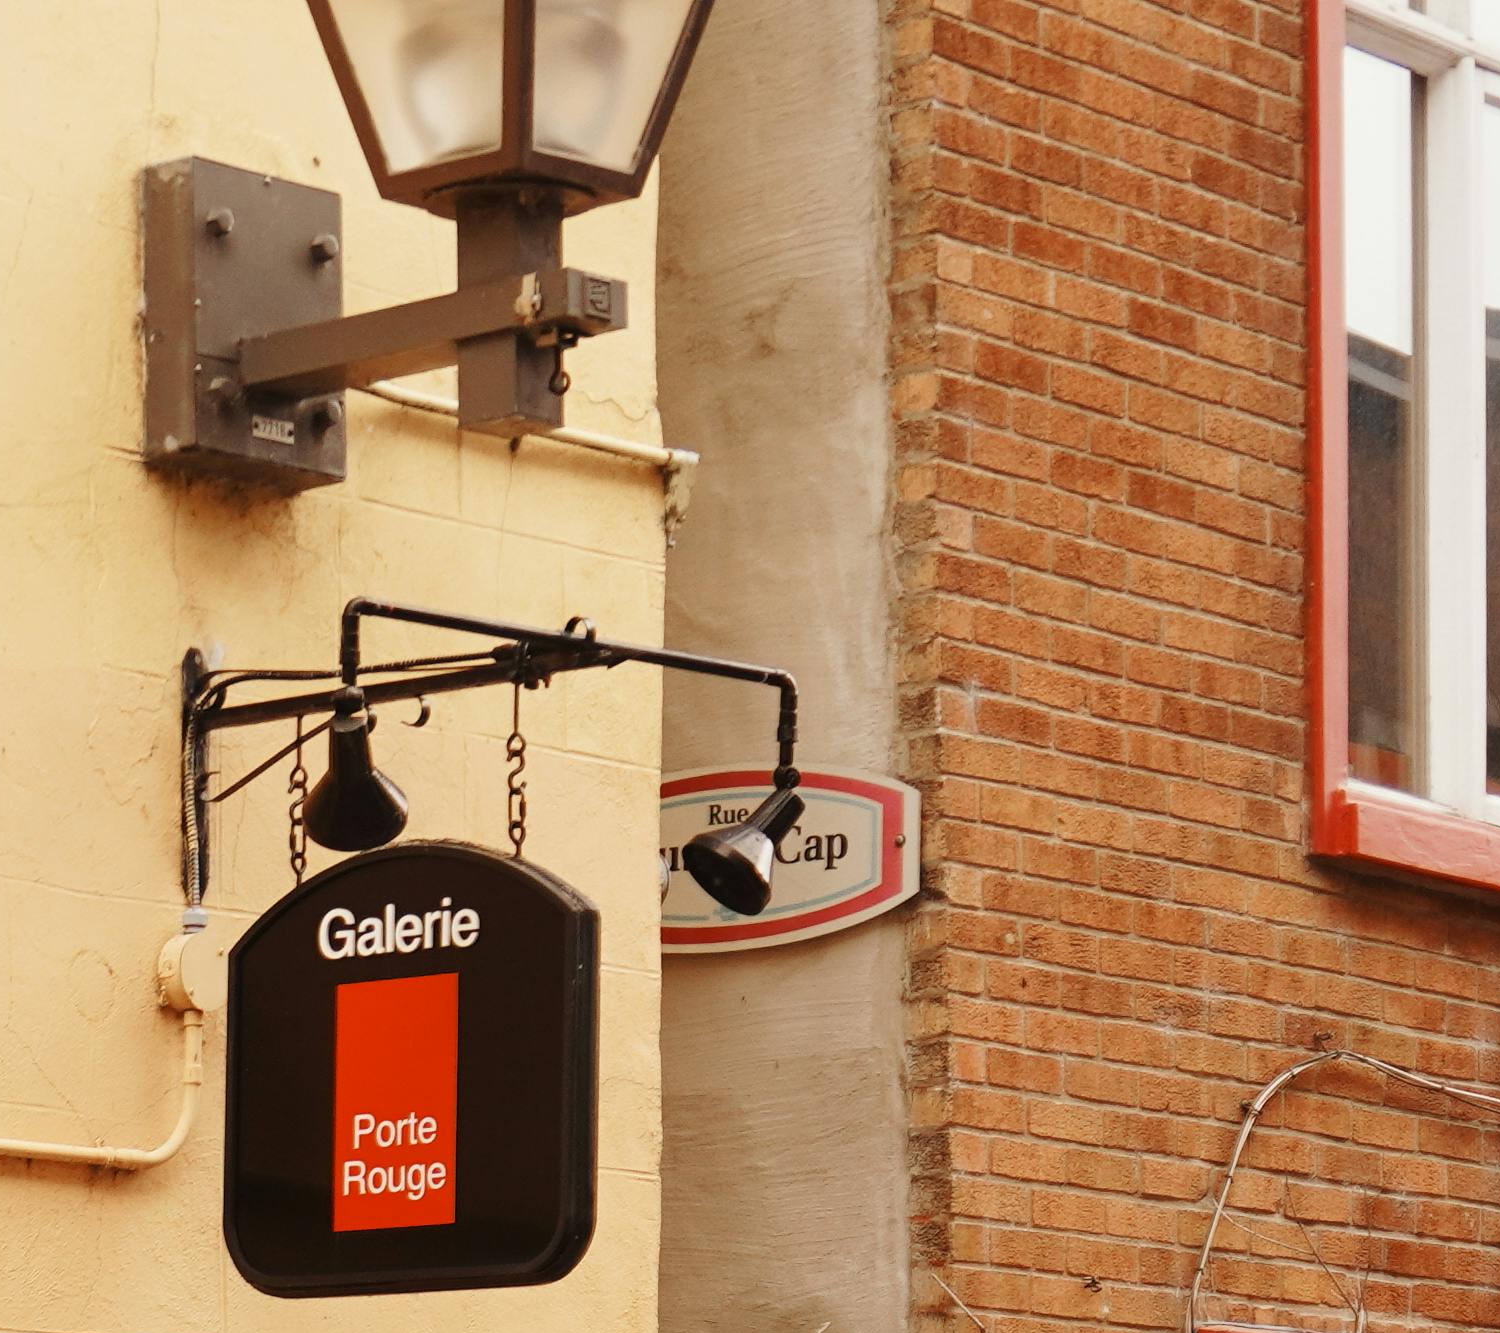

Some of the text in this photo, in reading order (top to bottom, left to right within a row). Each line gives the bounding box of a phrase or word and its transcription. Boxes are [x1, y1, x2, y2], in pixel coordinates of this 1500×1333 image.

[707, 804, 750, 826] Rue
[317, 896, 480, 961] Galerie
[352, 1111, 438, 1152] Porte
[341, 1157, 447, 1201] Rouge
